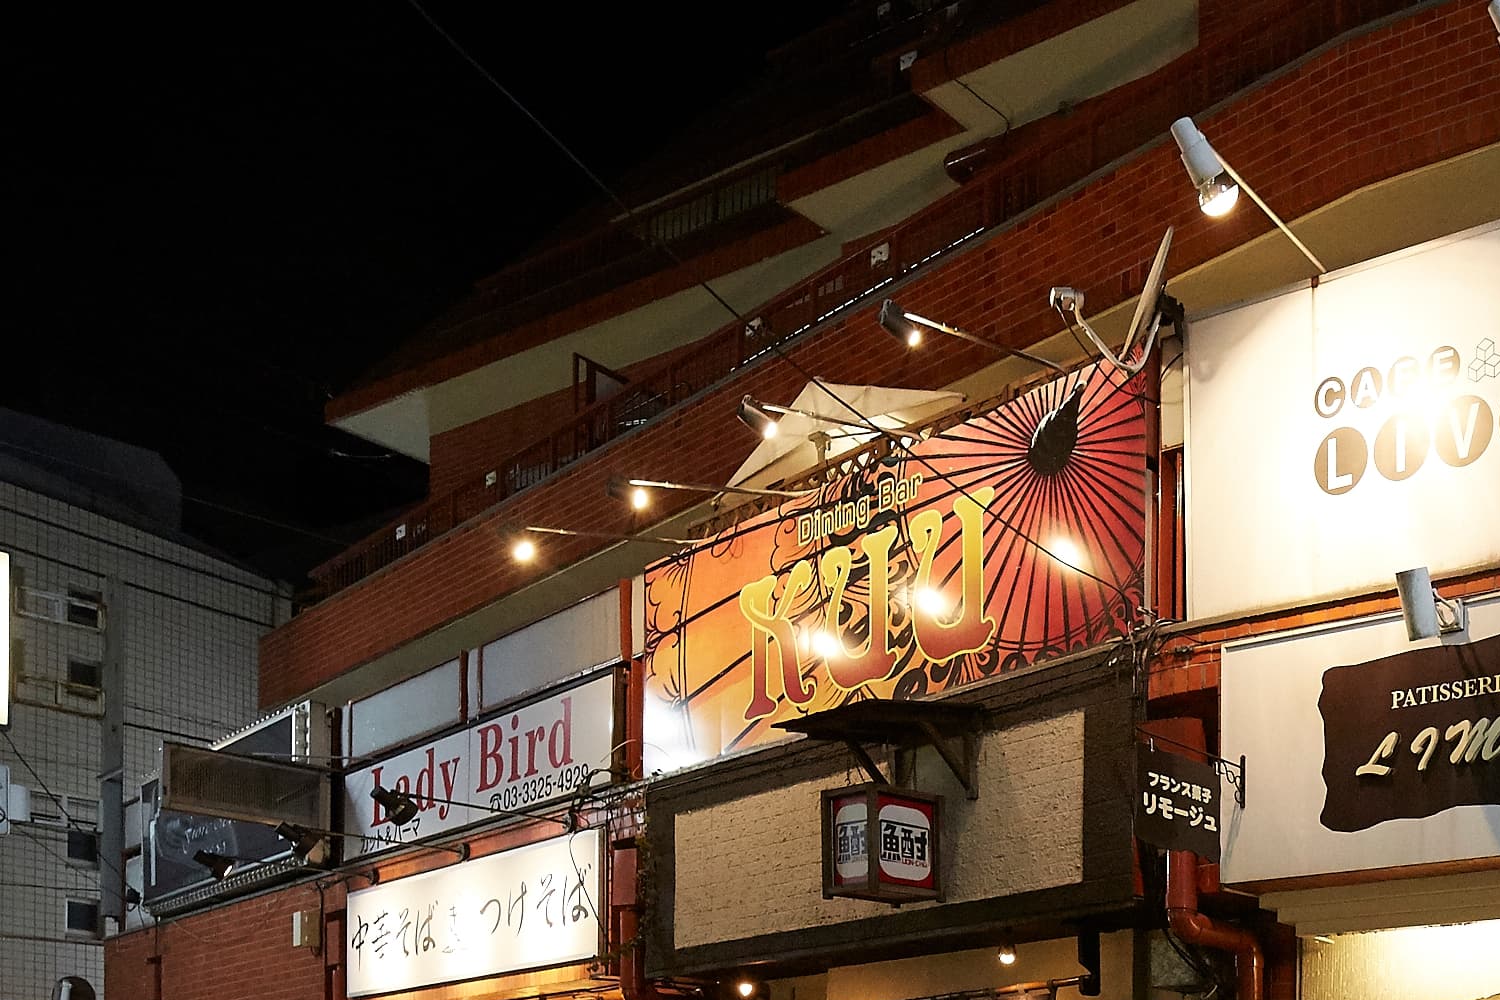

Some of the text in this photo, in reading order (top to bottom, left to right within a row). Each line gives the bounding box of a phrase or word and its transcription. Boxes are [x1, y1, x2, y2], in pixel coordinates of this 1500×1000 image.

[798, 472, 923, 546] Dining Bar
[740, 486, 995, 721] KUU
[476, 697, 574, 793] Bird
[1148, 771, 1212, 804] フランス菓子
[1144, 791, 1217, 832] リモージュ
[352, 900, 439, 972] 中華そば
[480, 863, 592, 937] つけそば
